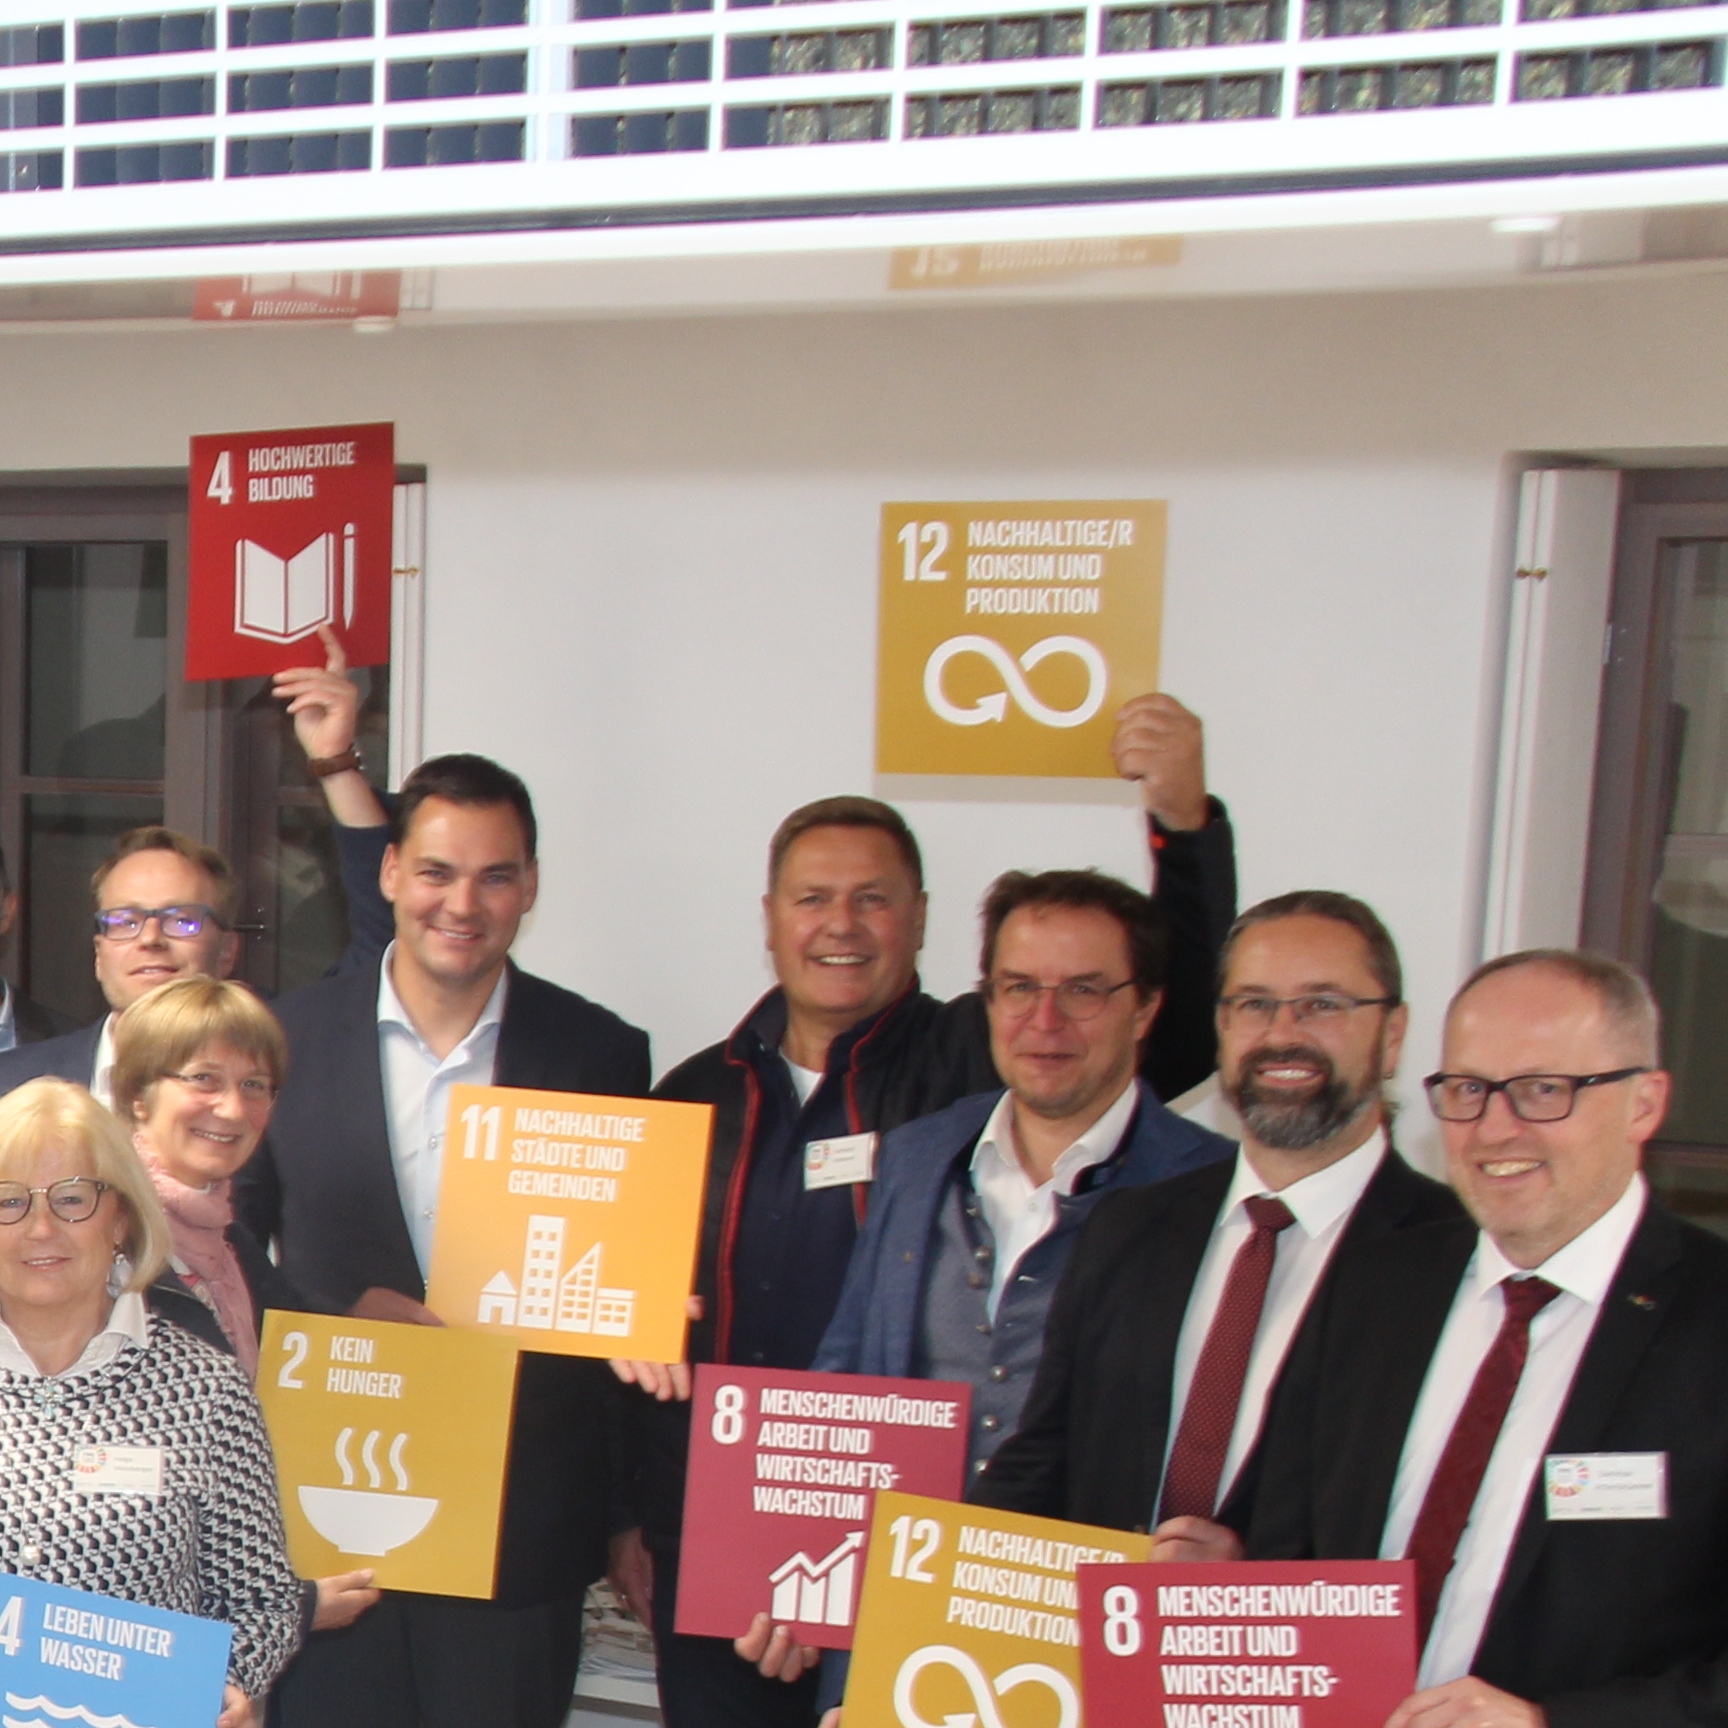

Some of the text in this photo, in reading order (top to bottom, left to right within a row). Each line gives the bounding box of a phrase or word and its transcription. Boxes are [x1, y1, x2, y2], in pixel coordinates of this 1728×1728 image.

[248, 442, 356, 472] HOCHWERTIGE
[207, 451, 233, 505] 4
[248, 474, 314, 502] BILDUNG
[897, 521, 949, 581] 12
[967, 519, 1134, 549] NACHHALTIGE/R
[966, 554, 1102, 581] KONSUM UND
[965, 587, 1100, 615] PRODUKTION
[461, 1105, 502, 1160] 11
[514, 1108, 647, 1142] NACHHALTIGE
[511, 1137, 626, 1172] STÄDTE UND
[508, 1169, 617, 1202] GEMEINDEN
[278, 1331, 308, 1389] 2
[330, 1335, 374, 1364] KEIN
[326, 1367, 402, 1398] HUNGER
[712, 1384, 744, 1444] 8
[760, 1388, 958, 1429] MENSCHENWÜRDIGE
[757, 1421, 871, 1454] ARBEIT UND
[756, 1453, 901, 1489] WIRTSCHAFTS-
[753, 1486, 867, 1520] WACHSTUM
[889, 1515, 940, 1583] 12
[952, 1561, 1040, 1602] KONSUM
[1158, 1580, 1402, 1617] MENSCHENWÜRDIGE
[43, 1603, 172, 1657] LEBEN UNTER
[947, 1596, 1079, 1646] PRODUKTION
[1103, 1585, 1140, 1656] 8
[1160, 1625, 1298, 1657] ARBEIT UND
[40, 1637, 124, 1681] WASSER
[1161, 1664, 1338, 1697] WIRTSCHAFTS-
